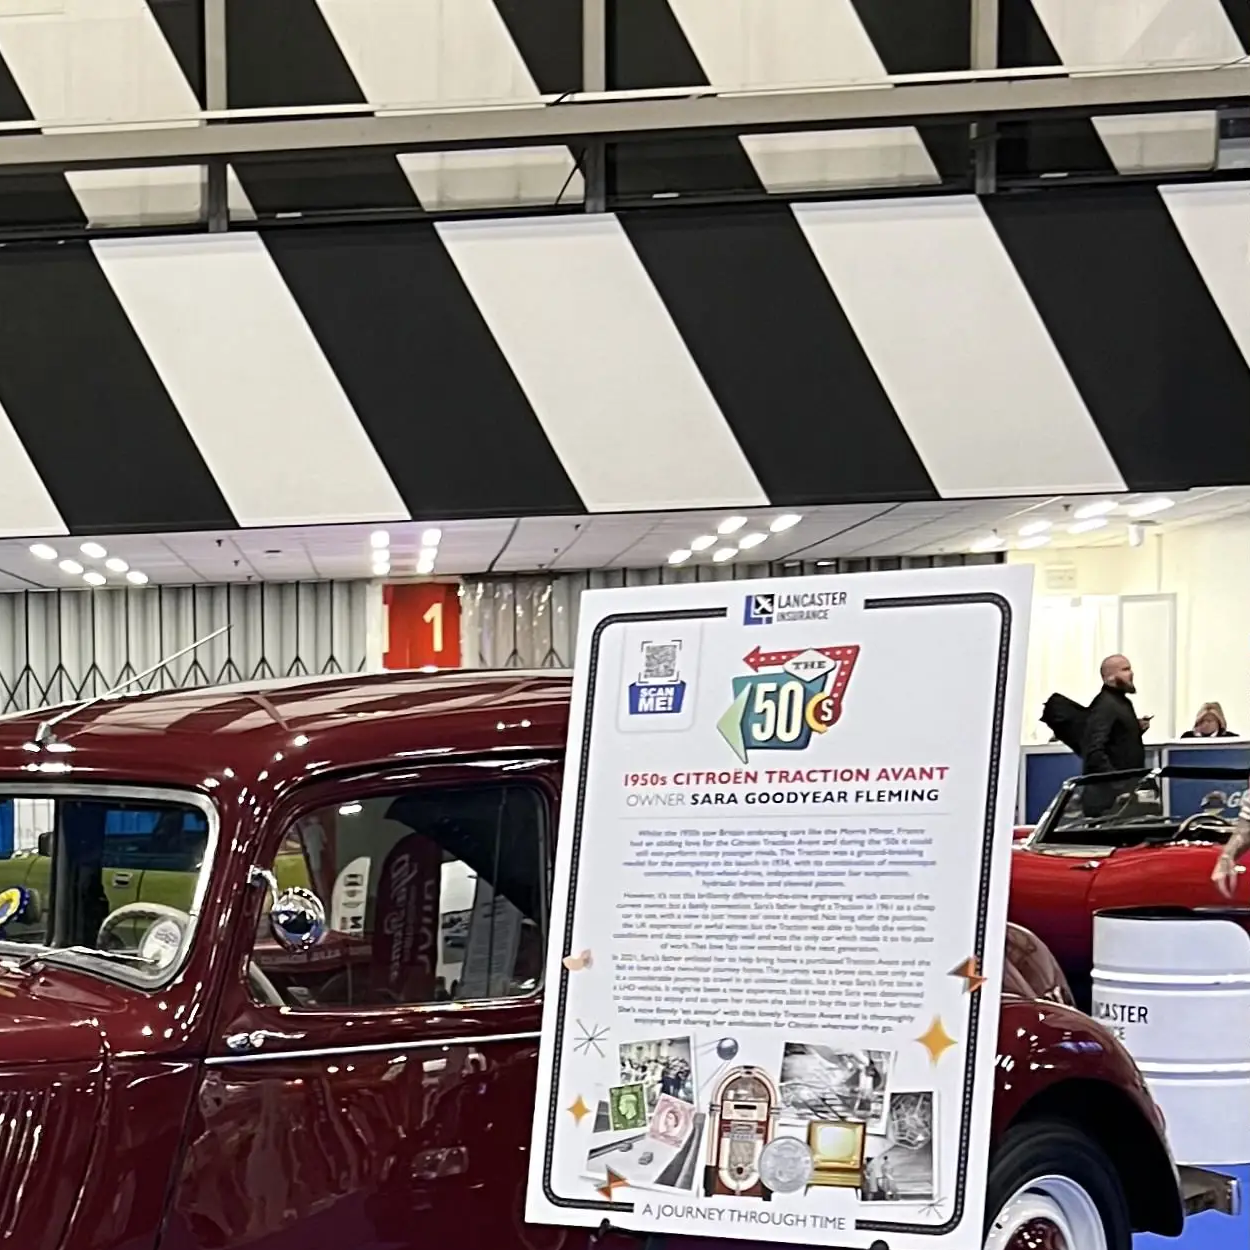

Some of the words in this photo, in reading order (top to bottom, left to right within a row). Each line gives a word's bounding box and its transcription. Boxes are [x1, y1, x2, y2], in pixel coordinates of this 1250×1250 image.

[778, 591, 847, 609] LANCASTER
[776, 609, 829, 622] INSURANCE
[792, 660, 827, 670] THE
[639, 686, 675, 699] SCAN
[638, 697, 674, 712] ME!
[624, 773, 667, 787] 1950s
[673, 768, 758, 785] CITROËN
[765, 769, 870, 784] TRACTION
[876, 766, 950, 781] AVANT
[626, 793, 686, 807] OWNER
[690, 792, 738, 805] SARA
[744, 790, 848, 804] GOODYEAR
[854, 789, 940, 803] FLEMING
[641, 1204, 653, 1216] A
[656, 1204, 726, 1221] JOURNEY
[727, 1209, 808, 1228] THROUGH
[810, 1215, 846, 1230] TIME
